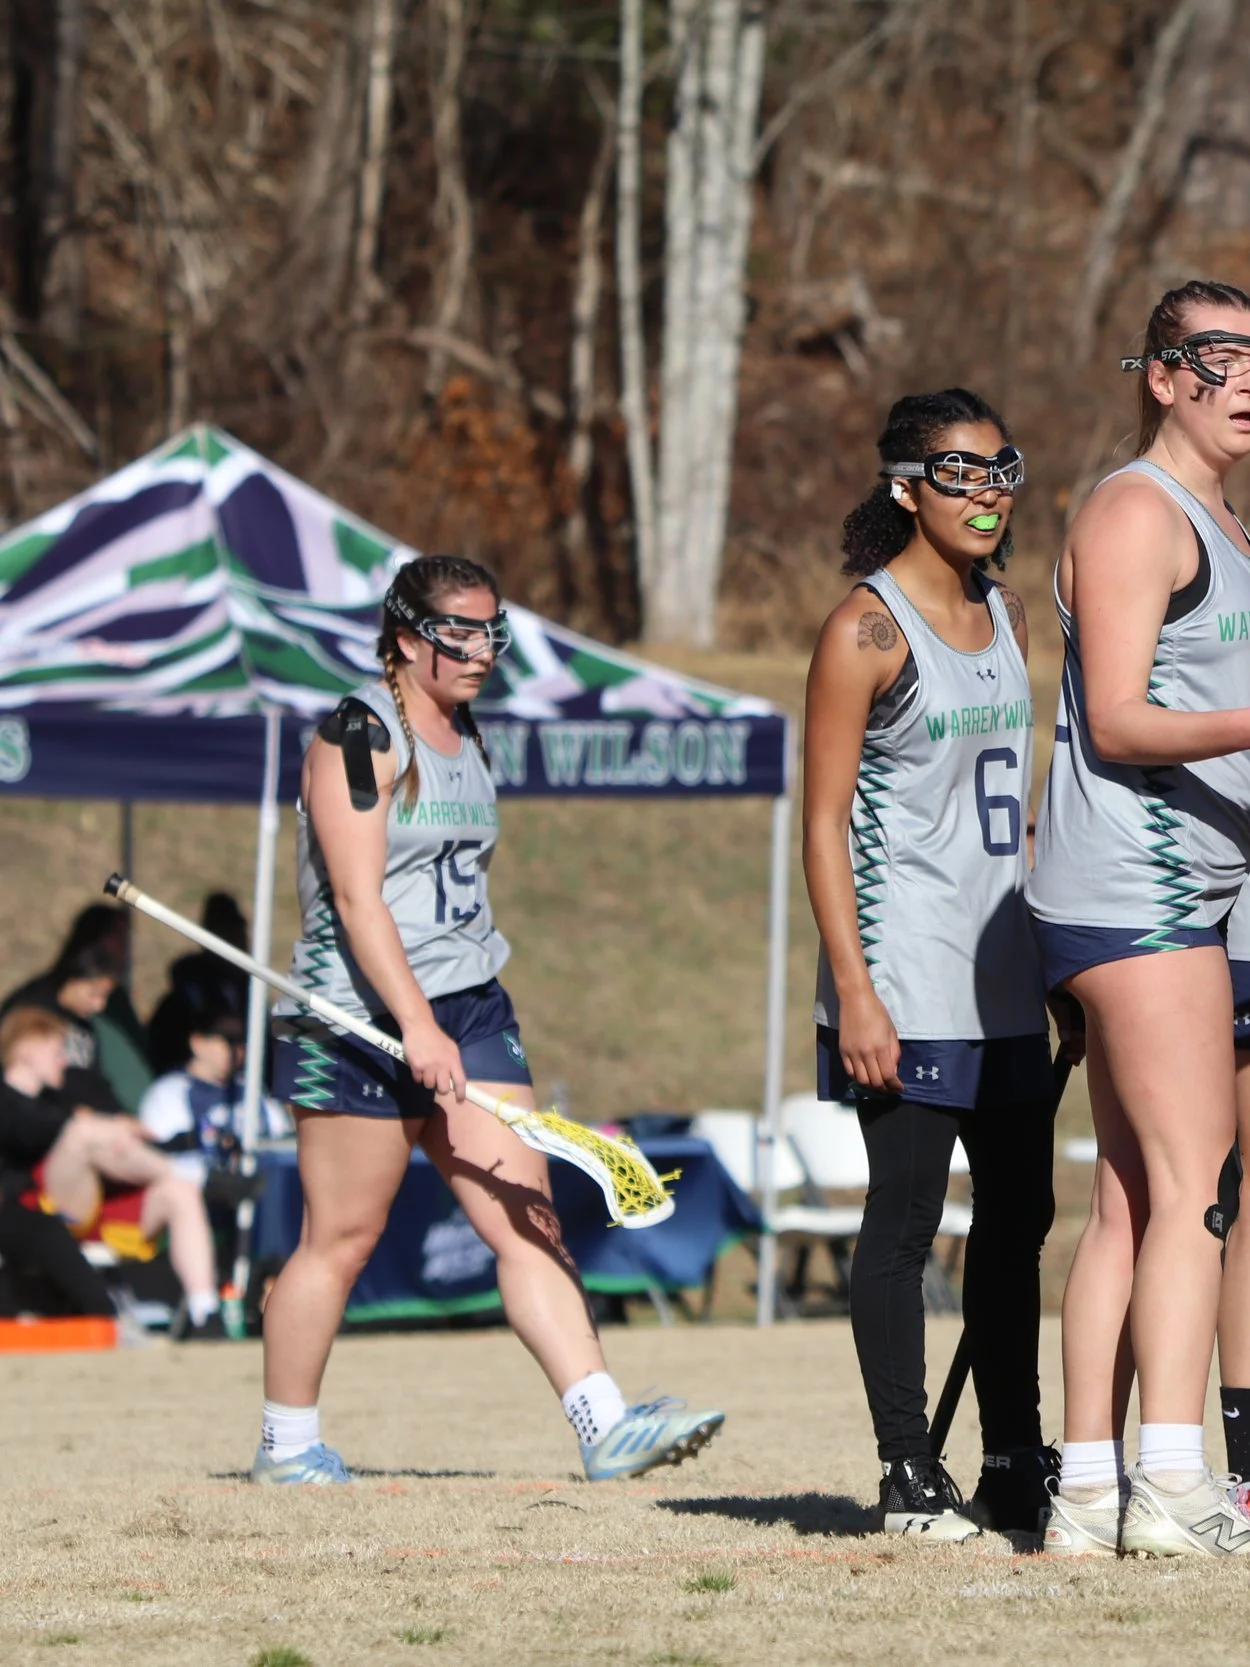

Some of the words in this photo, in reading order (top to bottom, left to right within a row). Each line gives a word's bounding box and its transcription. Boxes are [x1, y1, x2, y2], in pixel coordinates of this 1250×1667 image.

[1121, 357, 1143, 370] TX
[925, 704, 1000, 742] WARREN
[1004, 698, 1035, 730] WIL
[537, 719, 752, 787] WILSON
[396, 801, 468, 826] WARREN
[469, 802, 499, 827] WILS
[975, 747, 1020, 857] 6
[434, 840, 482, 925] 15
